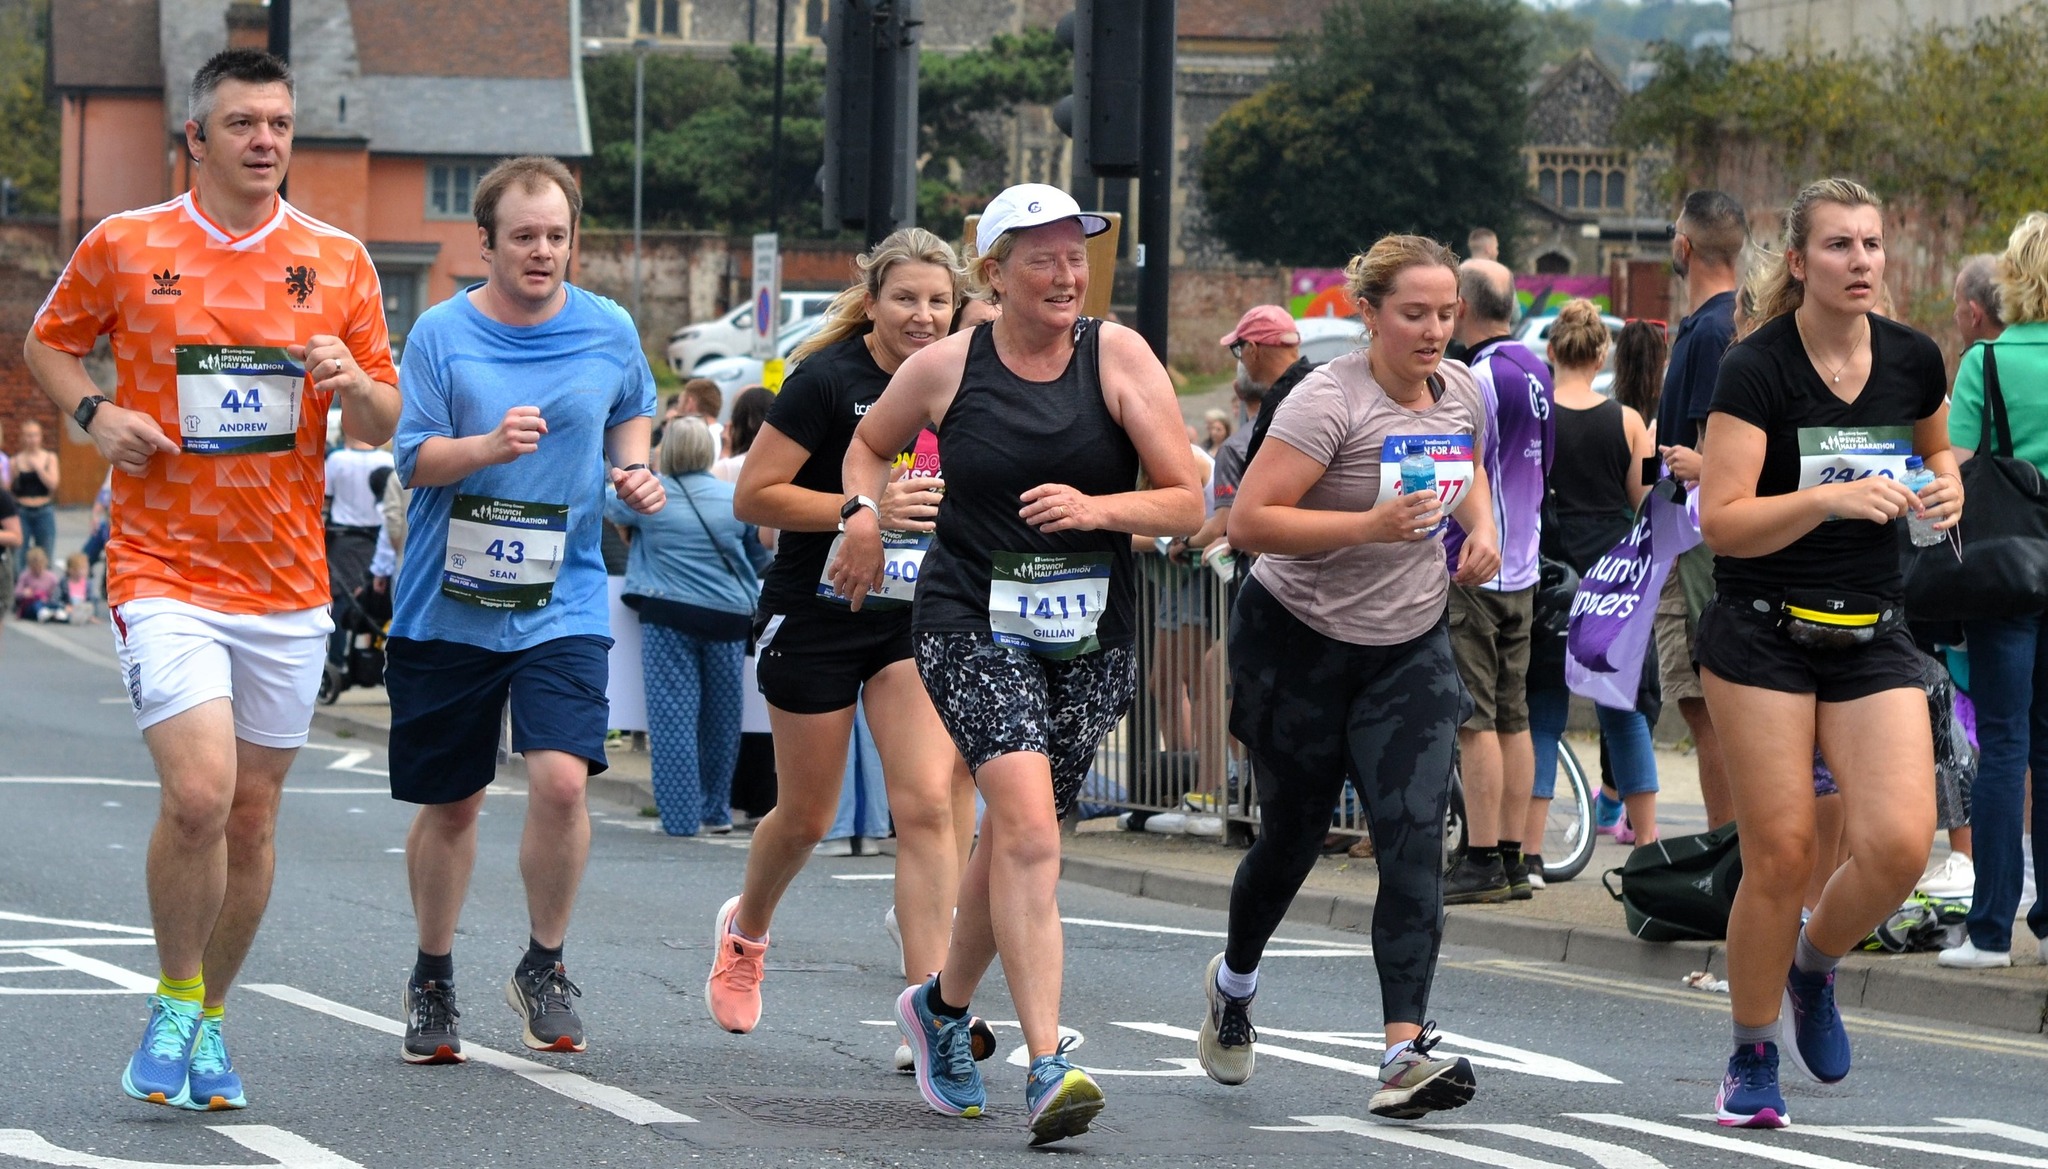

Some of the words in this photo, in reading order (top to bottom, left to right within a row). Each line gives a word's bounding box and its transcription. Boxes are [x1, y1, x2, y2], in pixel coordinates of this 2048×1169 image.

[151, 287, 182, 296] adidas
[221, 355, 253, 363] IPSWICH
[240, 362, 285, 370] MARATHON
[221, 389, 263, 413] 44
[219, 422, 268, 433] ANDREW
[1432, 446, 1449, 455] FOR
[1450, 446, 1462, 455] ALL
[493, 507, 522, 517] IPSWICH
[492, 513, 509, 521] HALF
[509, 515, 549, 525] MARATHON
[485, 539, 525, 564] 43
[1034, 563, 1064, 571] IPSWICH
[489, 569, 517, 580] SEAN
[1034, 570, 1052, 578] HALF
[1052, 567, 1091, 577] MARATHON
[537, 599, 547, 607] 43
[1018, 594, 1087, 619] 1411
[1033, 629, 1075, 638] GILLIAN
